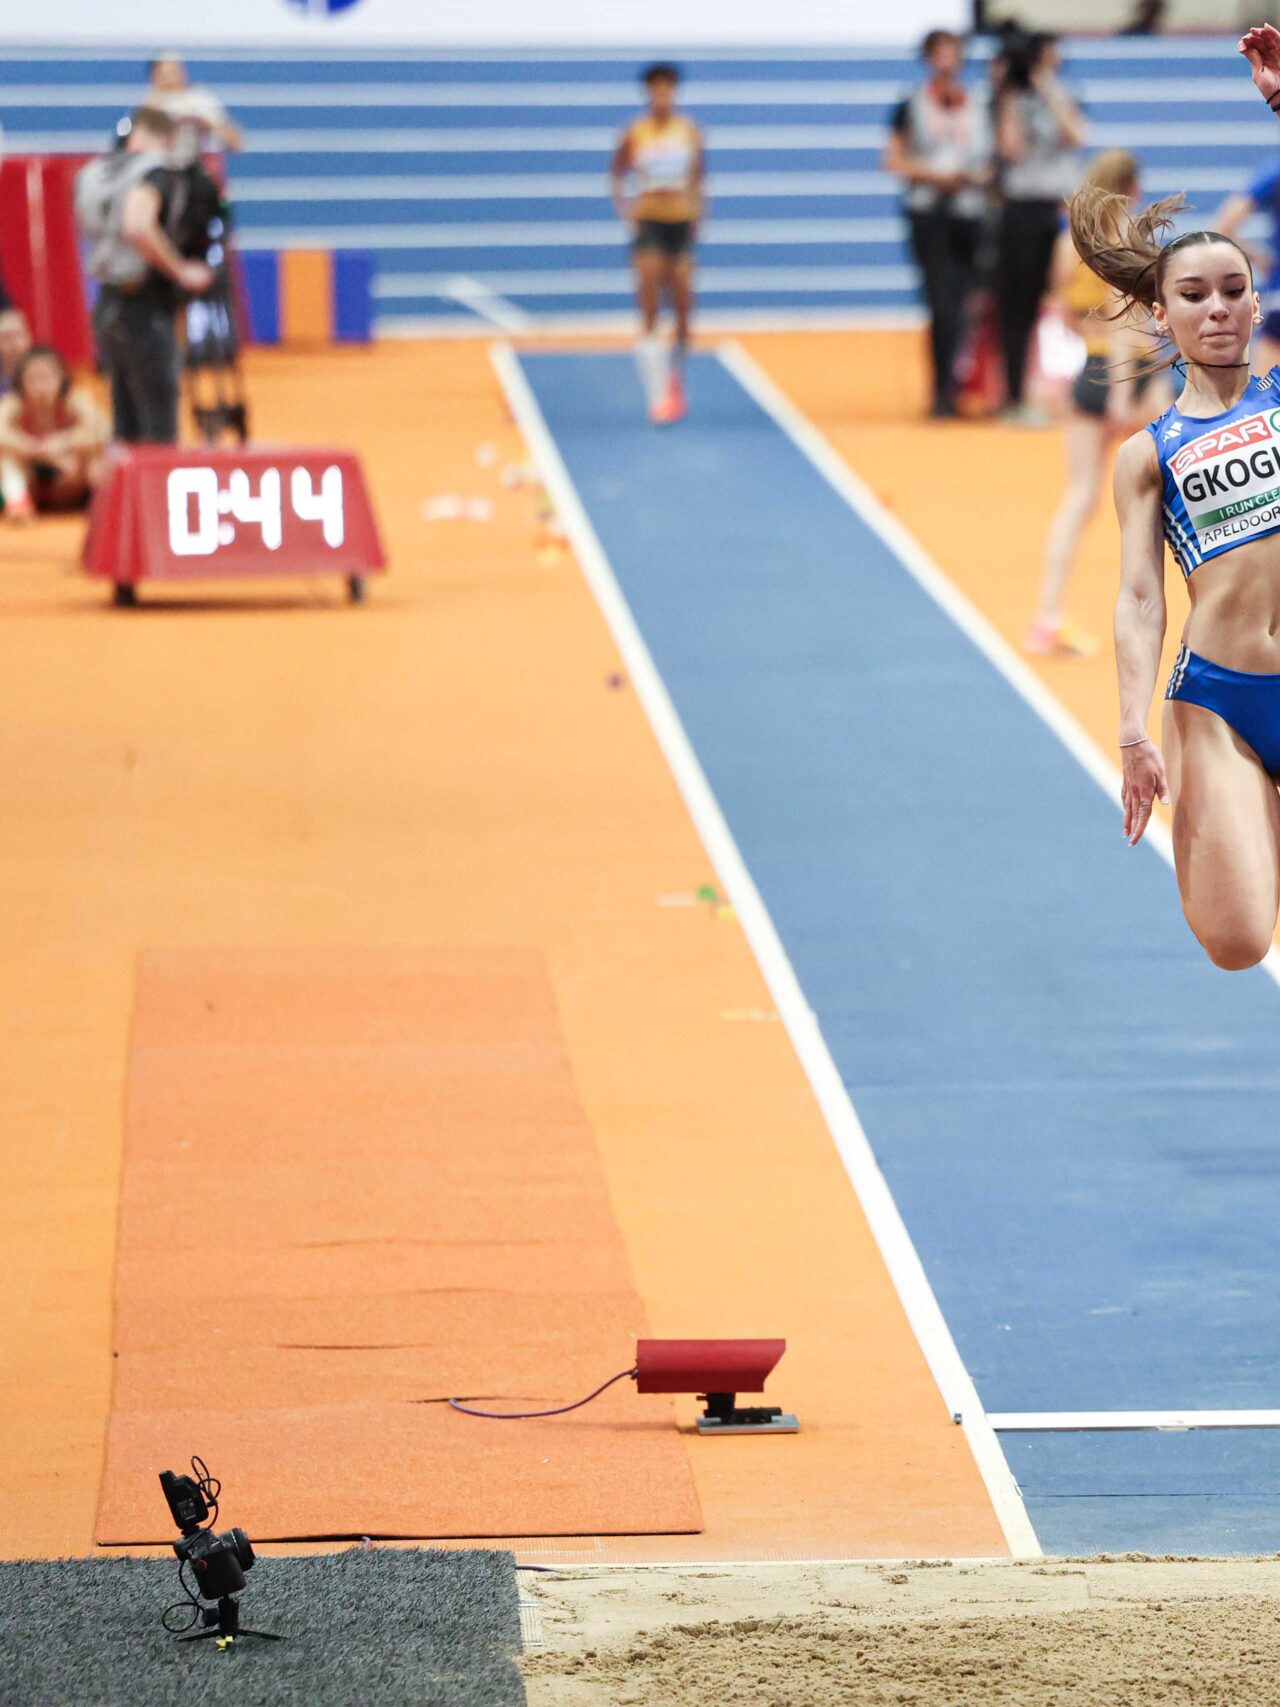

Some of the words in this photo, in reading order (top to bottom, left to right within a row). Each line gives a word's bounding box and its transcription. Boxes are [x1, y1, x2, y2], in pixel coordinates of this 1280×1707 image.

[1175, 420, 1269, 472] SPAR
[166, 464, 345, 556] 0:44
[1219, 509, 1225, 519] I
[1225, 498, 1254, 517] RUN
